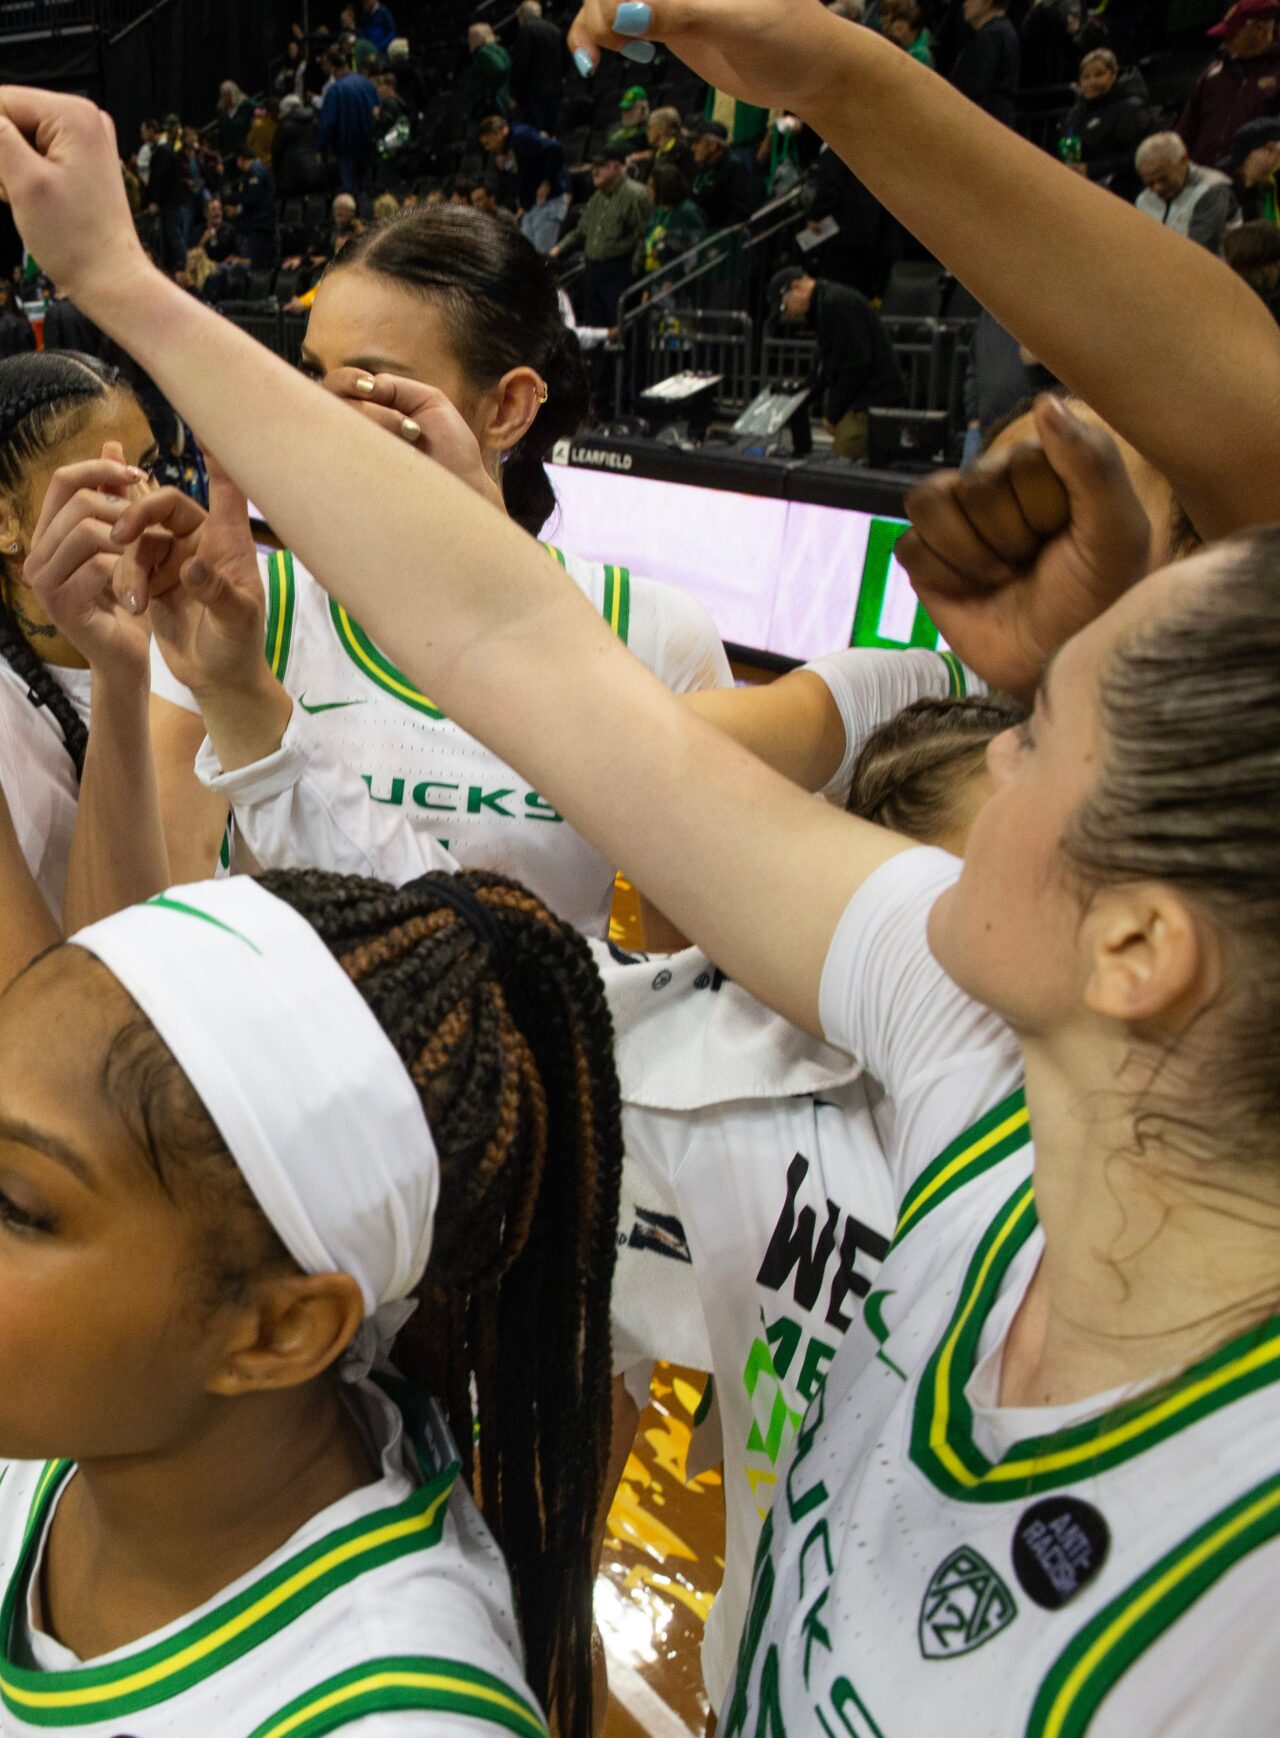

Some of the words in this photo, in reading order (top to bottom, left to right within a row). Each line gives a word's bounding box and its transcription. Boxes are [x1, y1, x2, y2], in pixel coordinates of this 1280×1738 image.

[571, 447, 632, 470] LEARFIELD
[361, 774, 565, 823] UCKS
[756, 1151, 891, 1334] WE
